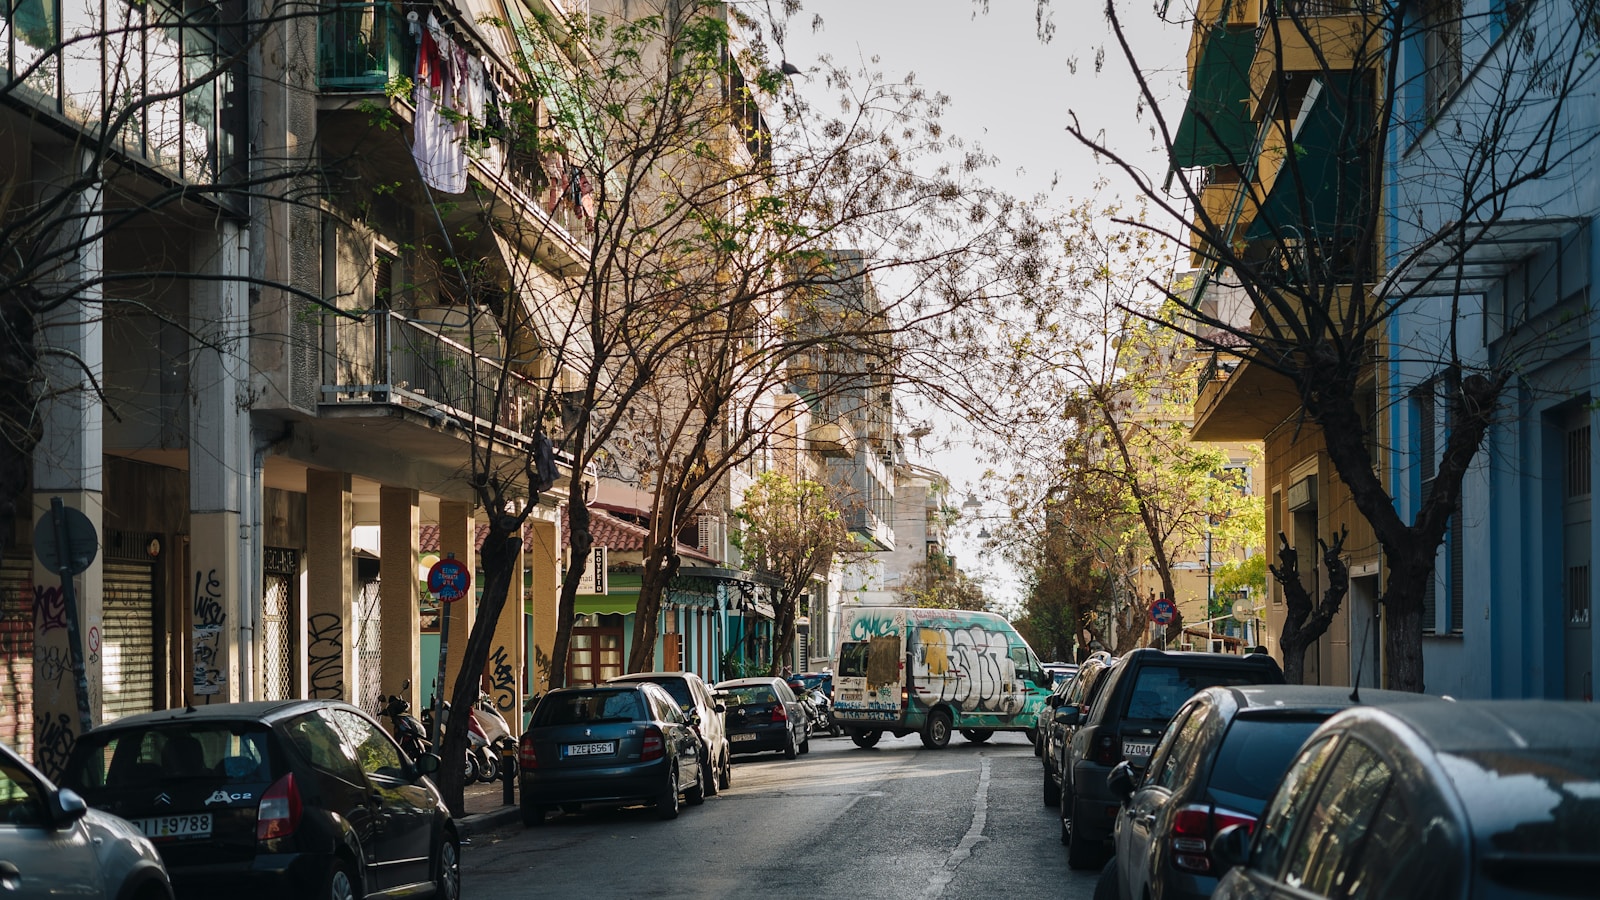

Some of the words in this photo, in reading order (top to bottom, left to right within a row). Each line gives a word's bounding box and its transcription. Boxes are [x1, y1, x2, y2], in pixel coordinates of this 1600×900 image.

[591, 743, 613, 753] 6561
[230, 792, 252, 800] C2
[169, 814, 209, 833] 9788
